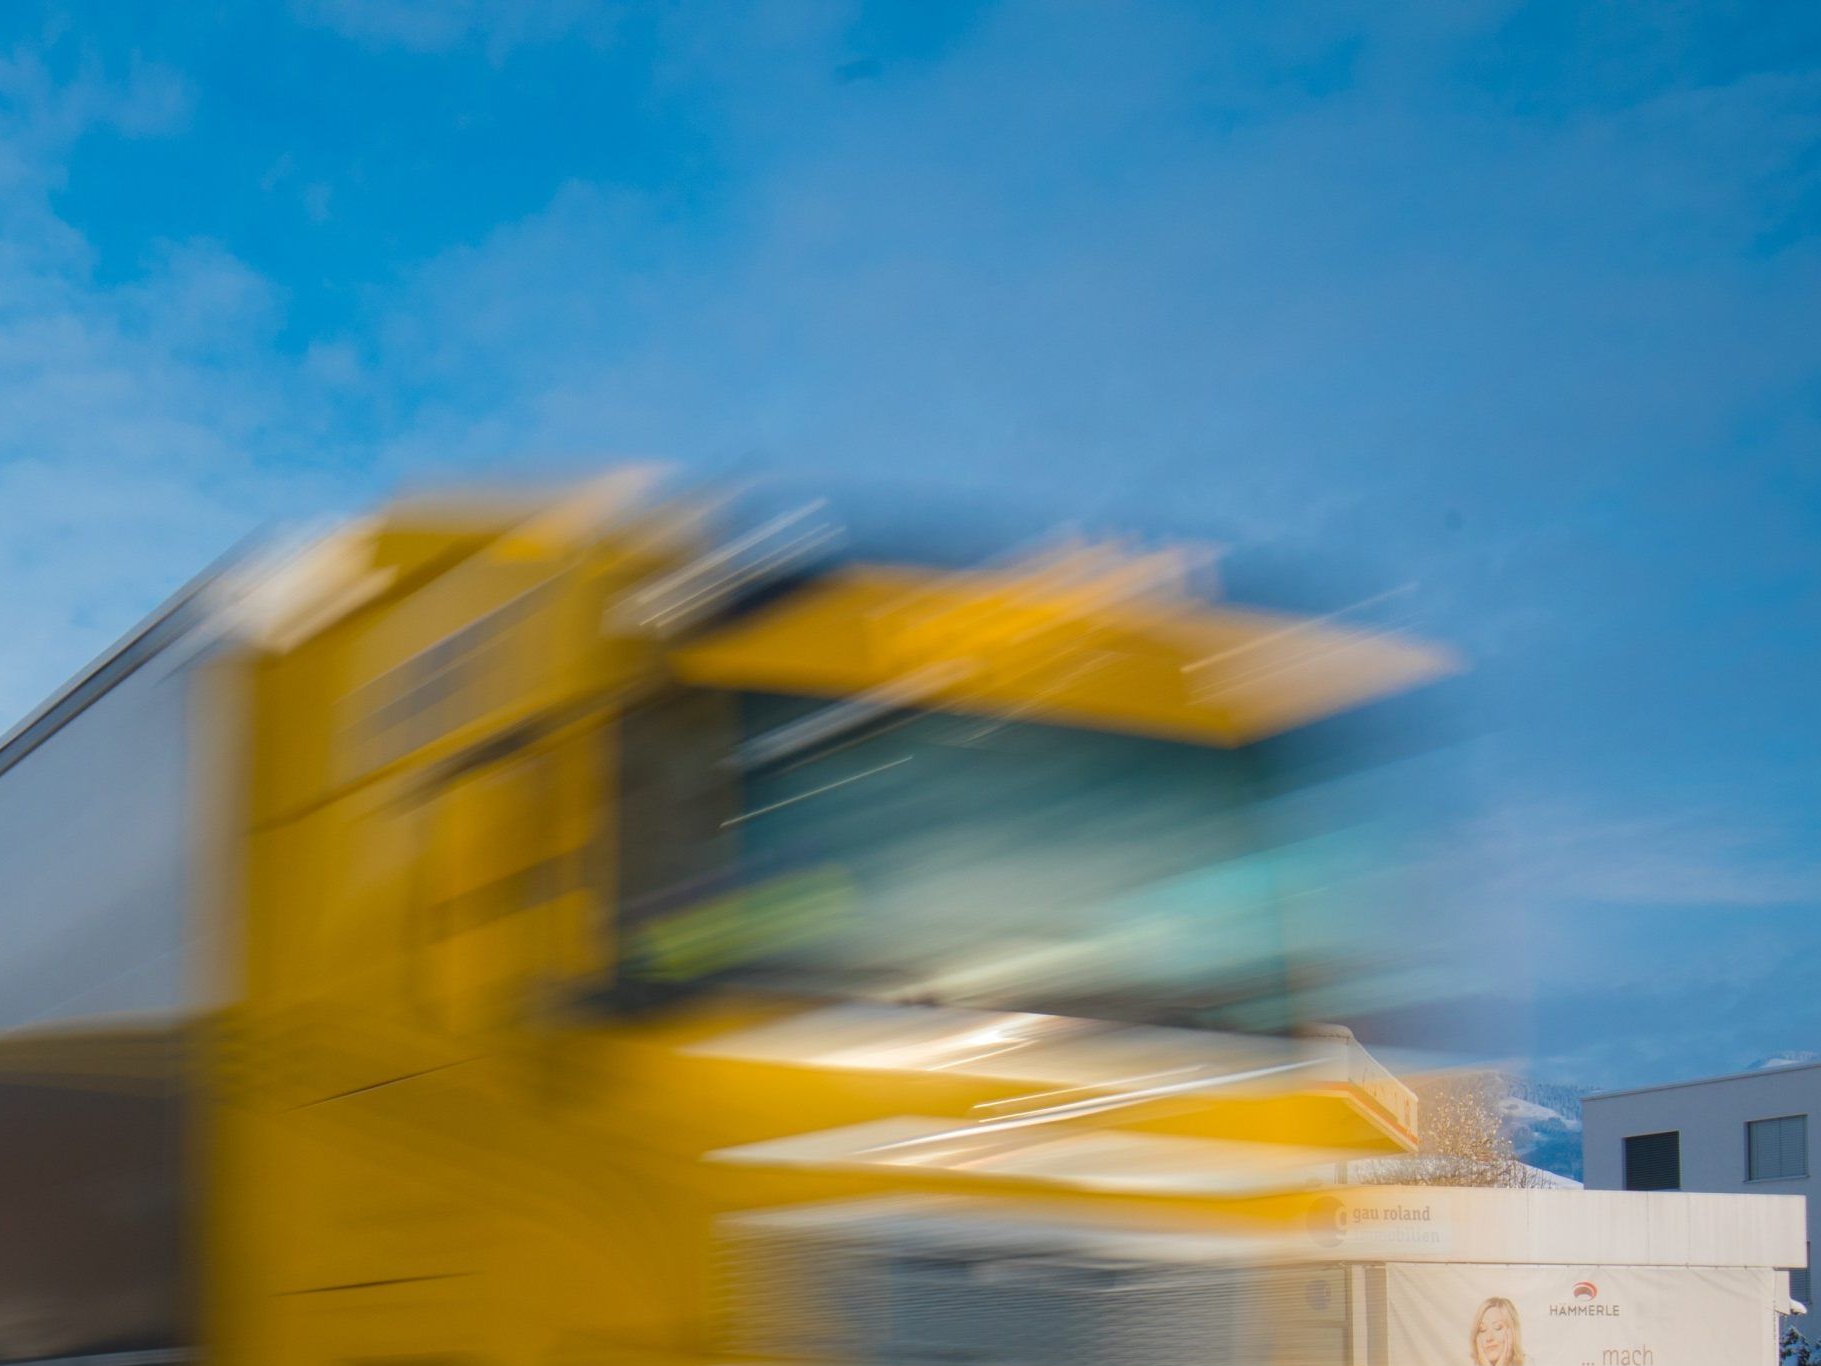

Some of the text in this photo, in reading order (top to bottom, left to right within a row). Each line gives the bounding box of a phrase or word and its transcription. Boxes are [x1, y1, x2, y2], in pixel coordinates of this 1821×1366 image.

[1352, 1205, 1431, 1223] gau roland
[1602, 1344, 1654, 1366] mach
